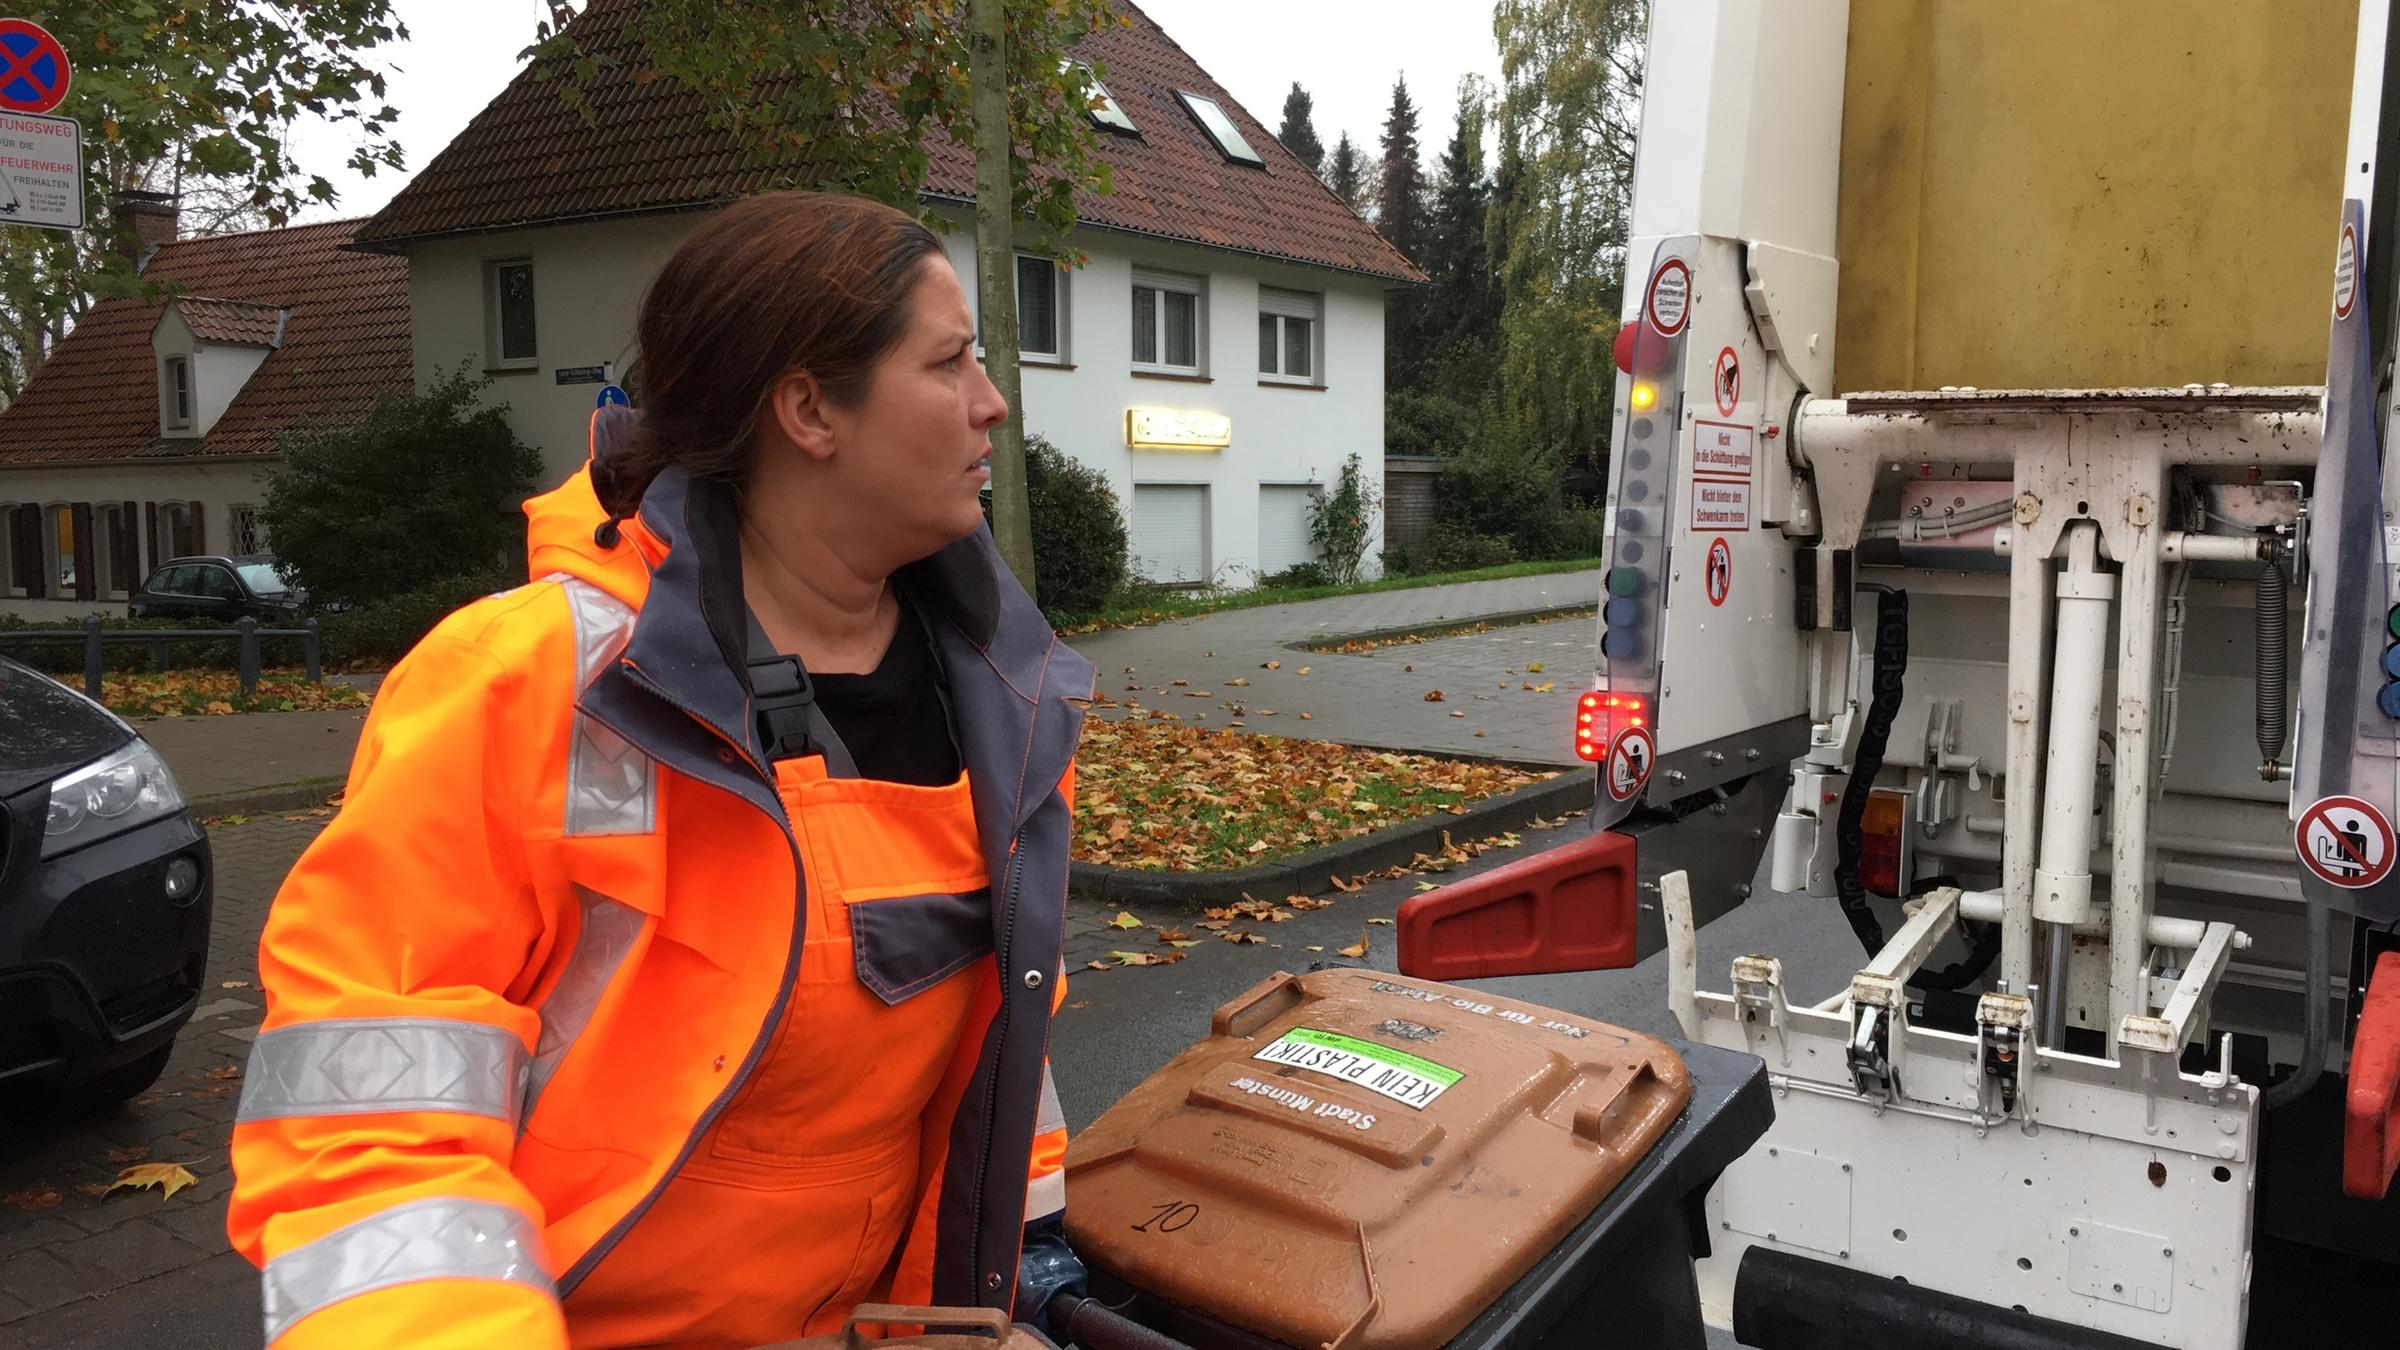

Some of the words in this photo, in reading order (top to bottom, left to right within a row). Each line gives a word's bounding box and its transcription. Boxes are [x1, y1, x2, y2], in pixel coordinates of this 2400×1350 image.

[19, 141, 34, 150] DIE
[1, 157, 74, 174] FEUERWEHR
[13, 176, 70, 189] FREIHALTEN
[1702, 489, 1715, 502] Nicht
[1496, 1009, 1536, 1025] für
[1539, 1021, 1591, 1038] Nur
[1263, 1041, 1375, 1079] PLASTIK!
[1229, 1076, 1316, 1112] Münster
[1371, 1068, 1439, 1105] KEIN
[1313, 1102, 1377, 1131] Stadt
[1131, 1201, 1199, 1233] 10
